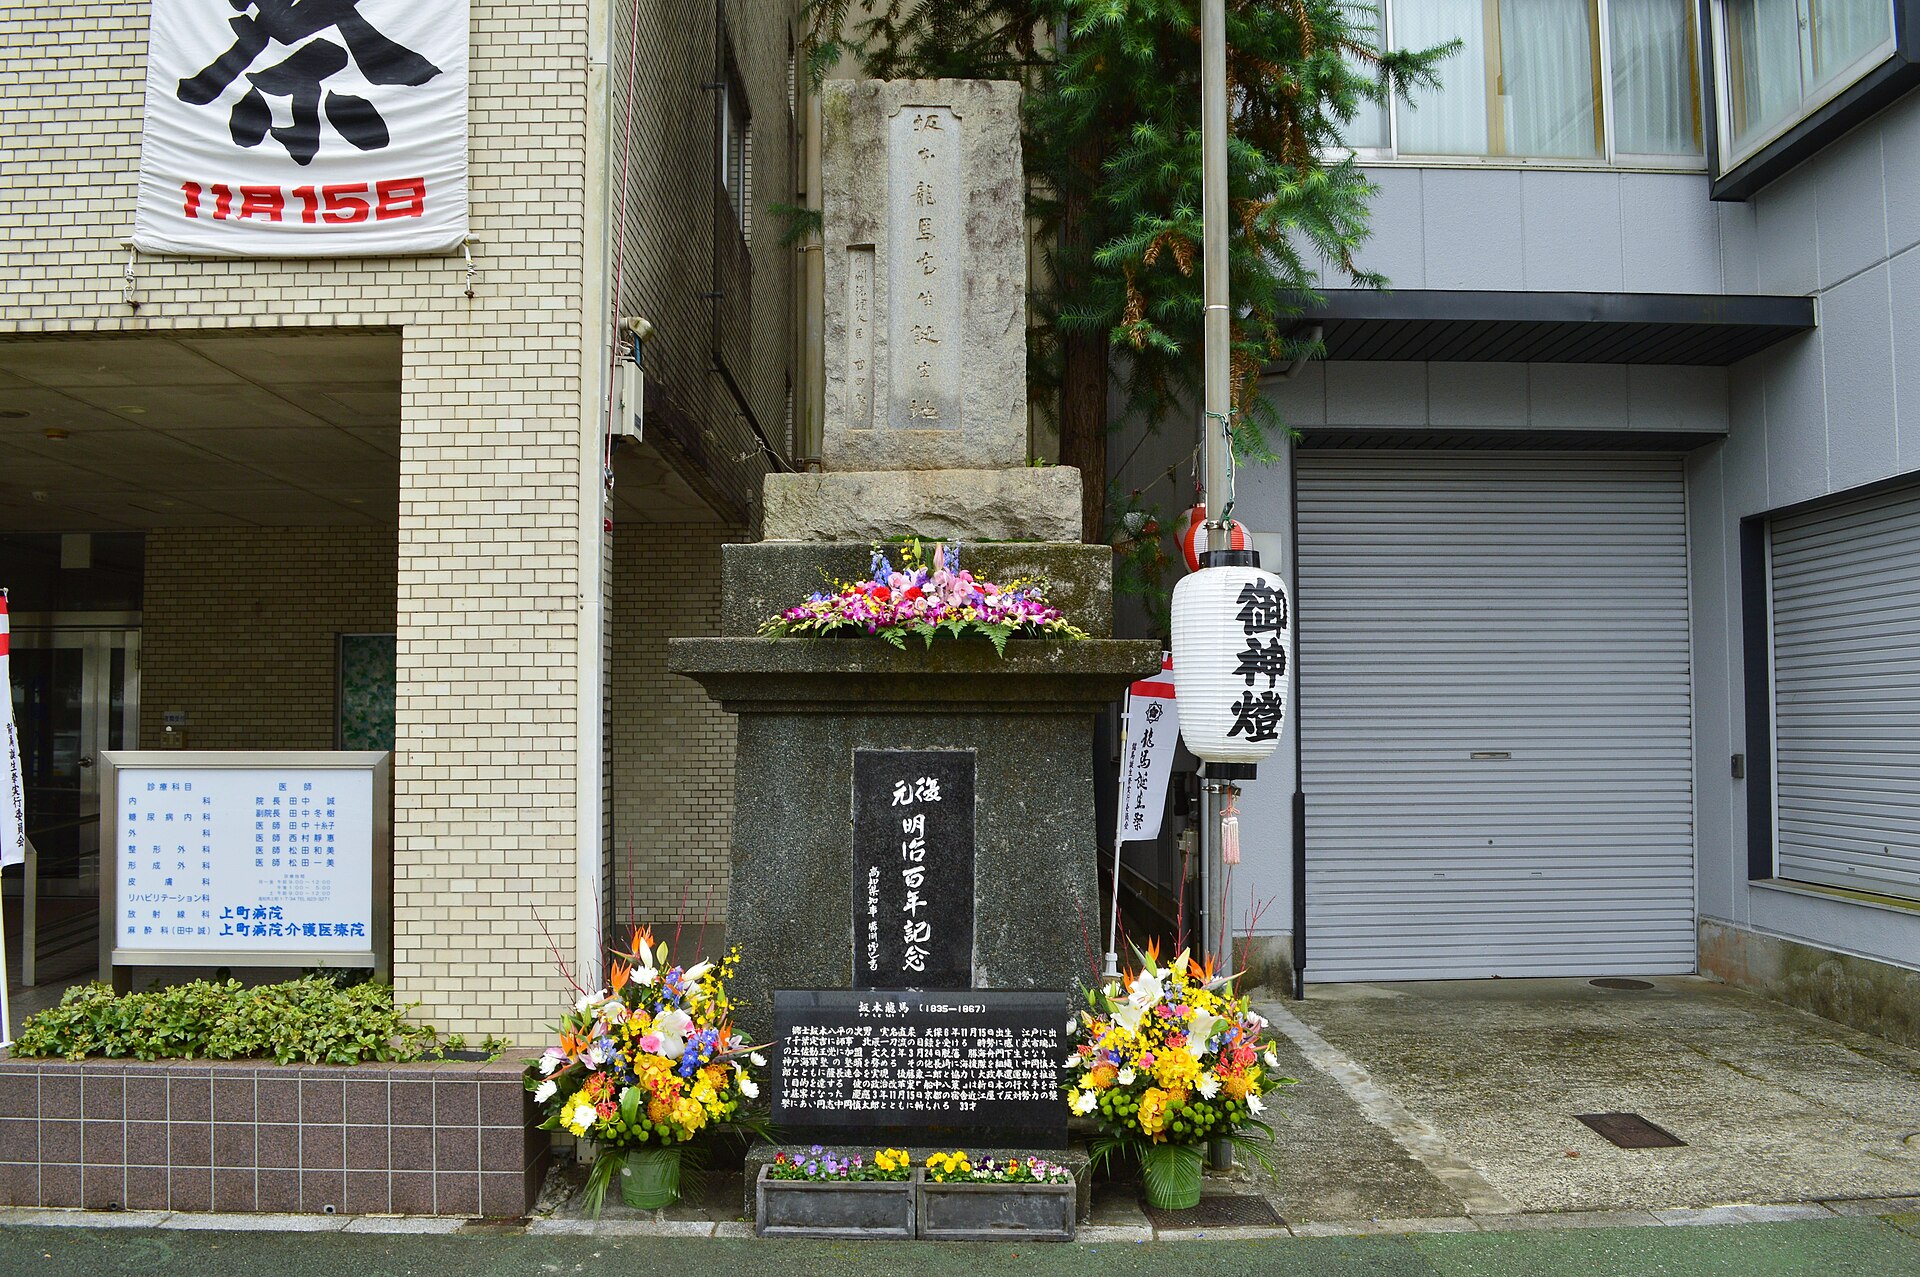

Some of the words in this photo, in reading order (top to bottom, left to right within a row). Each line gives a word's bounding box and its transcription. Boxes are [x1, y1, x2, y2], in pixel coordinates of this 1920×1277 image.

[180, 177, 426, 224] 11月15日
[1227, 577, 1288, 743] 御神燈
[147, 783, 192, 792] 診療科目
[256, 809, 280, 817] 副院長
[128, 845, 211, 854] 整形外科
[128, 861, 210, 870] 形成外科
[902, 813, 931, 972] 明治百年記念
[128, 894, 210, 903] リハビリテーション科
[128, 910, 210, 919] 放射線科
[219, 905, 283, 920] 上町病院
[219, 922, 365, 937] 上町病院介護医療院
[858, 1001, 909, 1014] 坂本龍馬
[1021, 1027, 1057, 1037] 江戸に出
